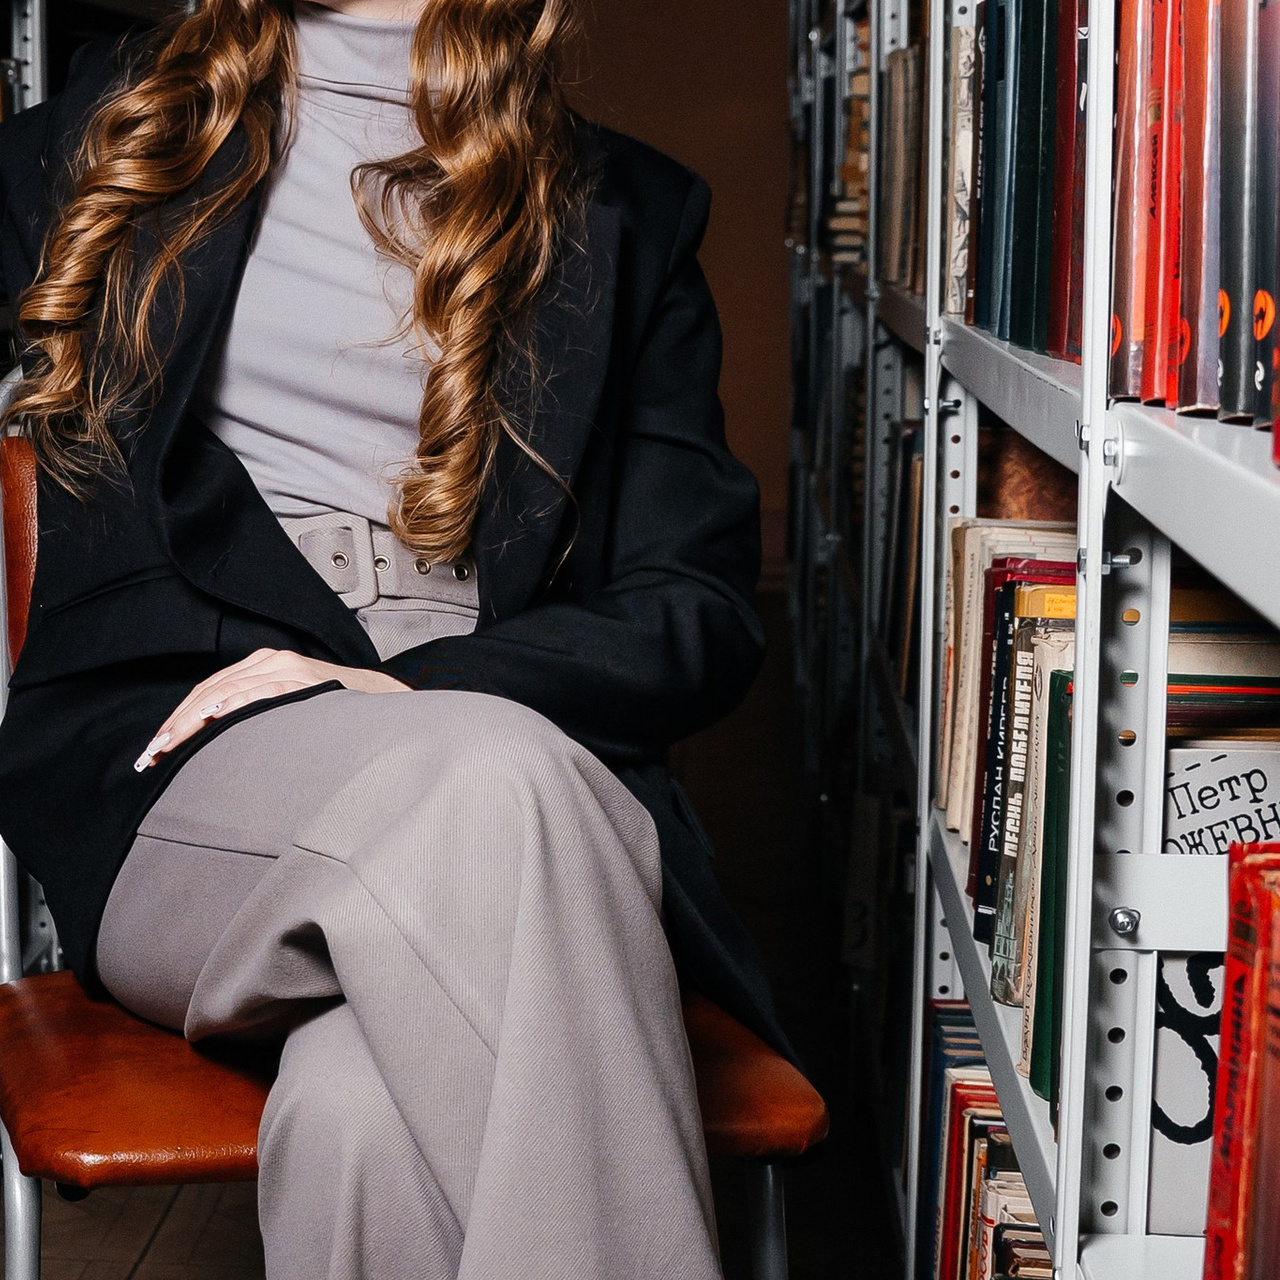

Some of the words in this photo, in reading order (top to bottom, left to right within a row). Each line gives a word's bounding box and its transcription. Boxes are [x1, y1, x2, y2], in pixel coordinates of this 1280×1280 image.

[987, 767, 1003, 853] РУСЛАН
[1003, 792, 1025, 859] ПЕСНЬ
[1169, 767, 1269, 823] Петр
